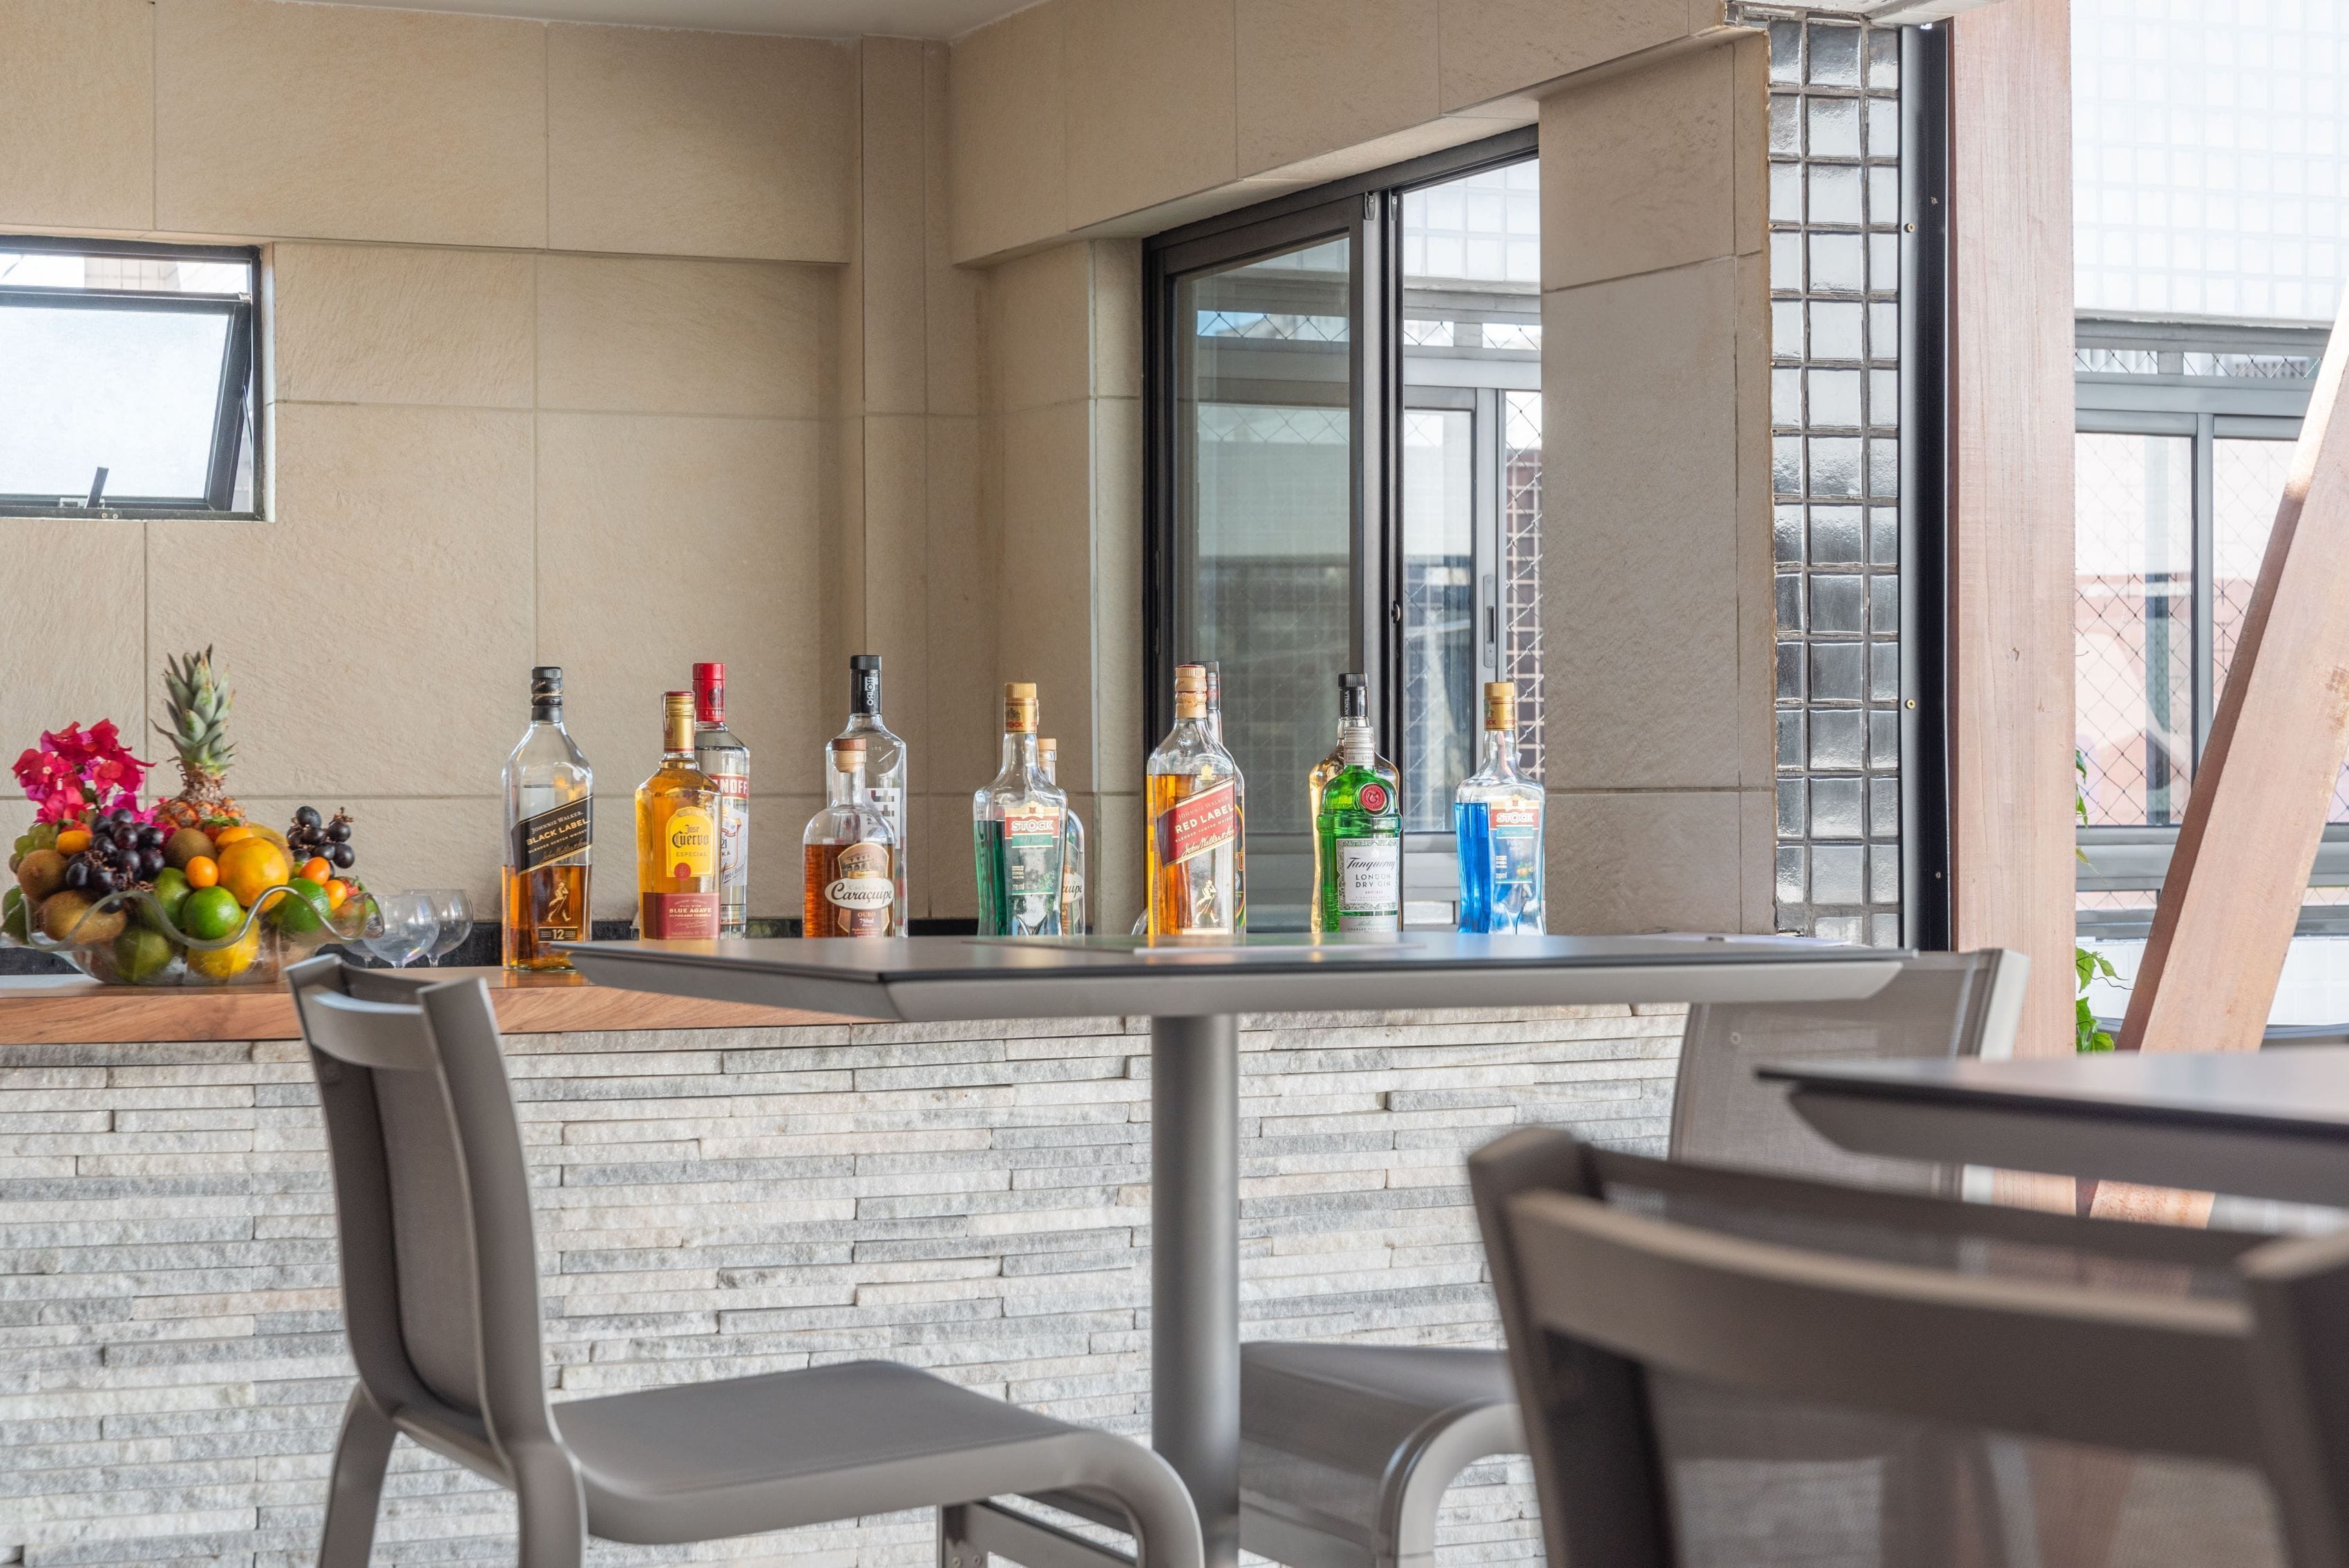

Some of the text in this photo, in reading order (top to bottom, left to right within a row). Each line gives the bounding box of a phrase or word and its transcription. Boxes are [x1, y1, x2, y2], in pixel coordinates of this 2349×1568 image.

[1179, 796, 1228, 821] JOHNNIE WALKER
[1496, 811, 1534, 824] STOCK
[531, 811, 583, 834] JOHNNIE WALKER
[1011, 819, 1054, 832] STOCK
[1175, 804, 1234, 834] RED LABEL
[526, 829, 558, 845] BLACK
[559, 819, 591, 834] LABEL
[672, 830, 710, 848] Cuervo
[1347, 857, 1396, 871] Tanqueray
[552, 929, 564, 939] 12
